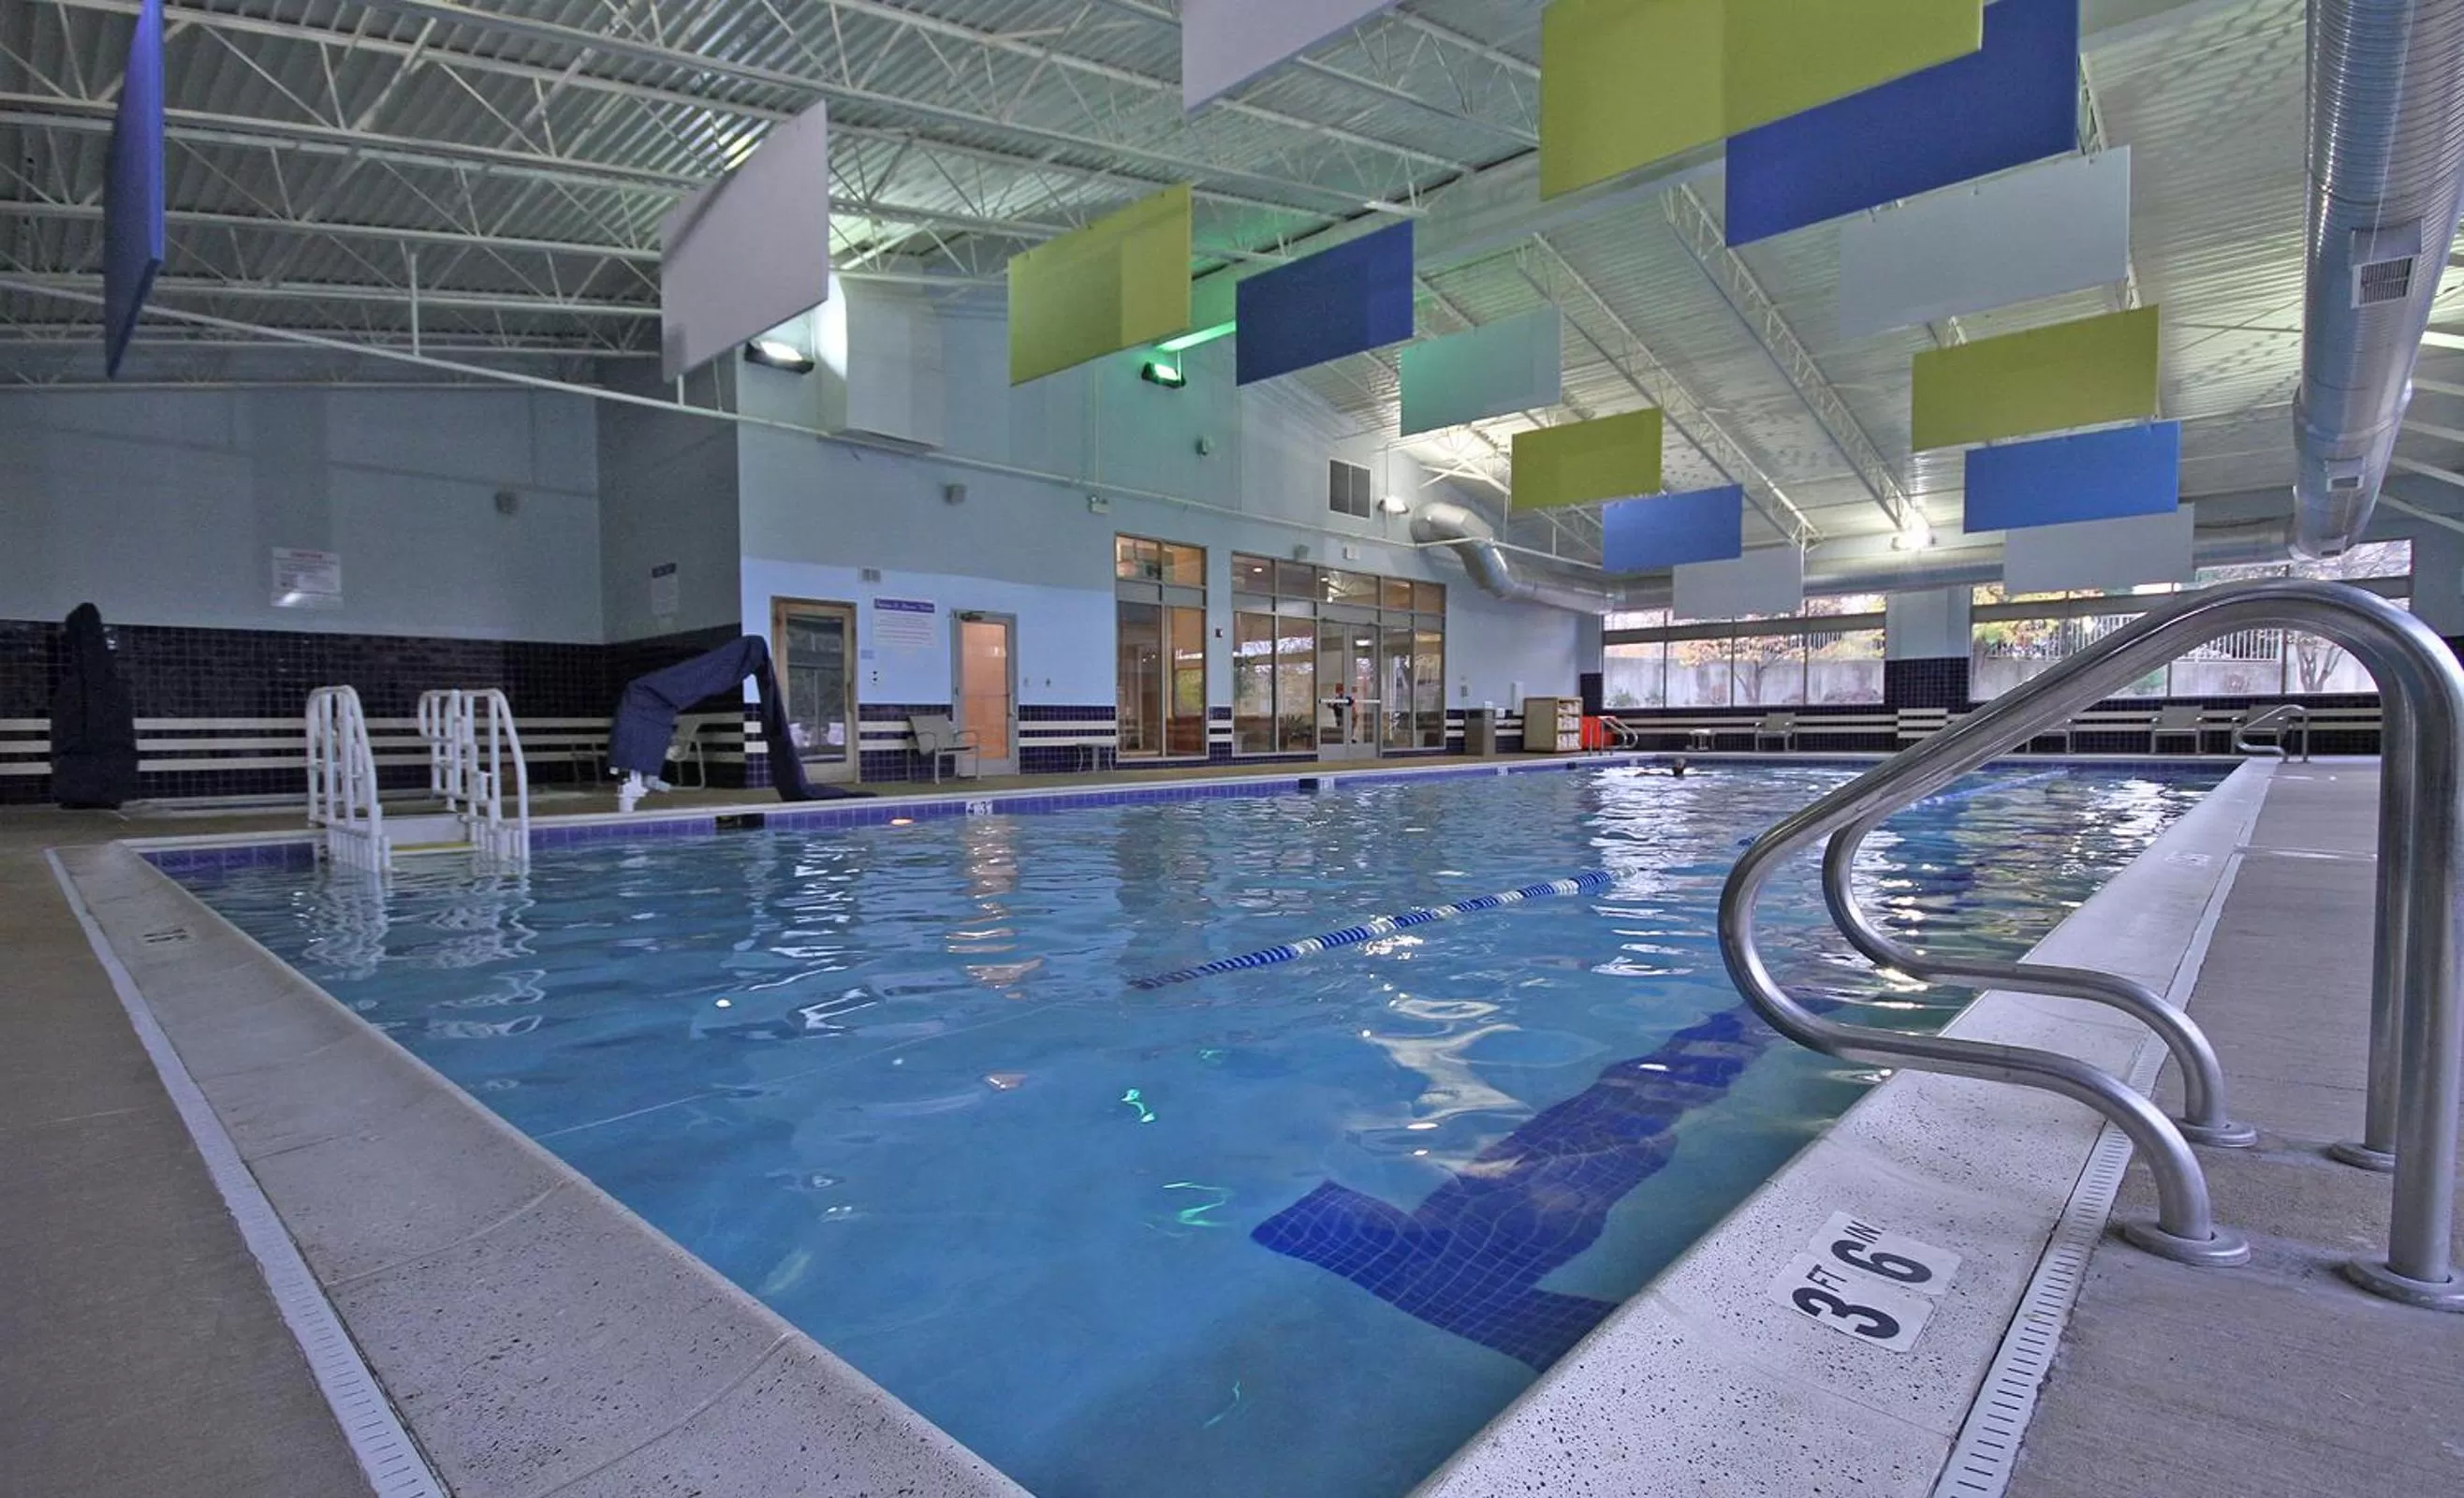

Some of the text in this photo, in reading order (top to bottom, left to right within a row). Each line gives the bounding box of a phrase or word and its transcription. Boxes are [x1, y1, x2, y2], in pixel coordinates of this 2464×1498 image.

[1792, 1220, 1932, 1340] 3 FT 6 IN
